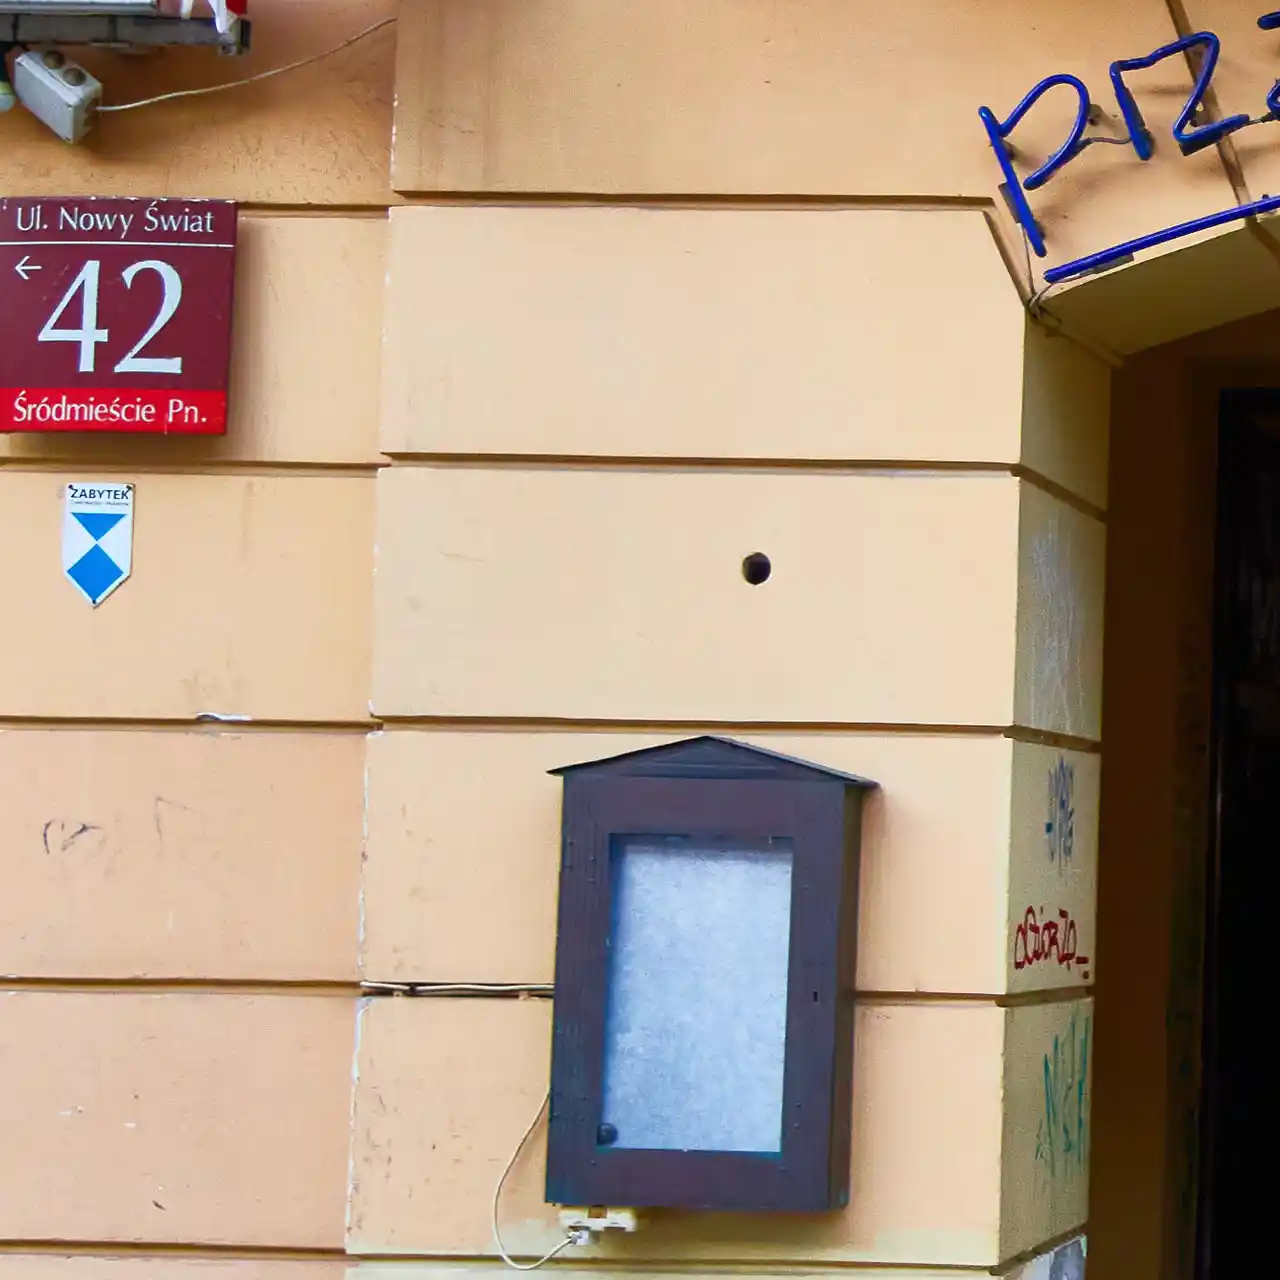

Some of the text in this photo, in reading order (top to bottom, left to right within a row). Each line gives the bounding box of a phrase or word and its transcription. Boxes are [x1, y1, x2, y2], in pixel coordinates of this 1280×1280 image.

[16, 200, 215, 239] Ul. Nowy Świat
[37, 259, 184, 375] 42
[13, 389, 208, 424] Śródmieście Pn.
[70, 488, 129, 500] ZABYTEK
